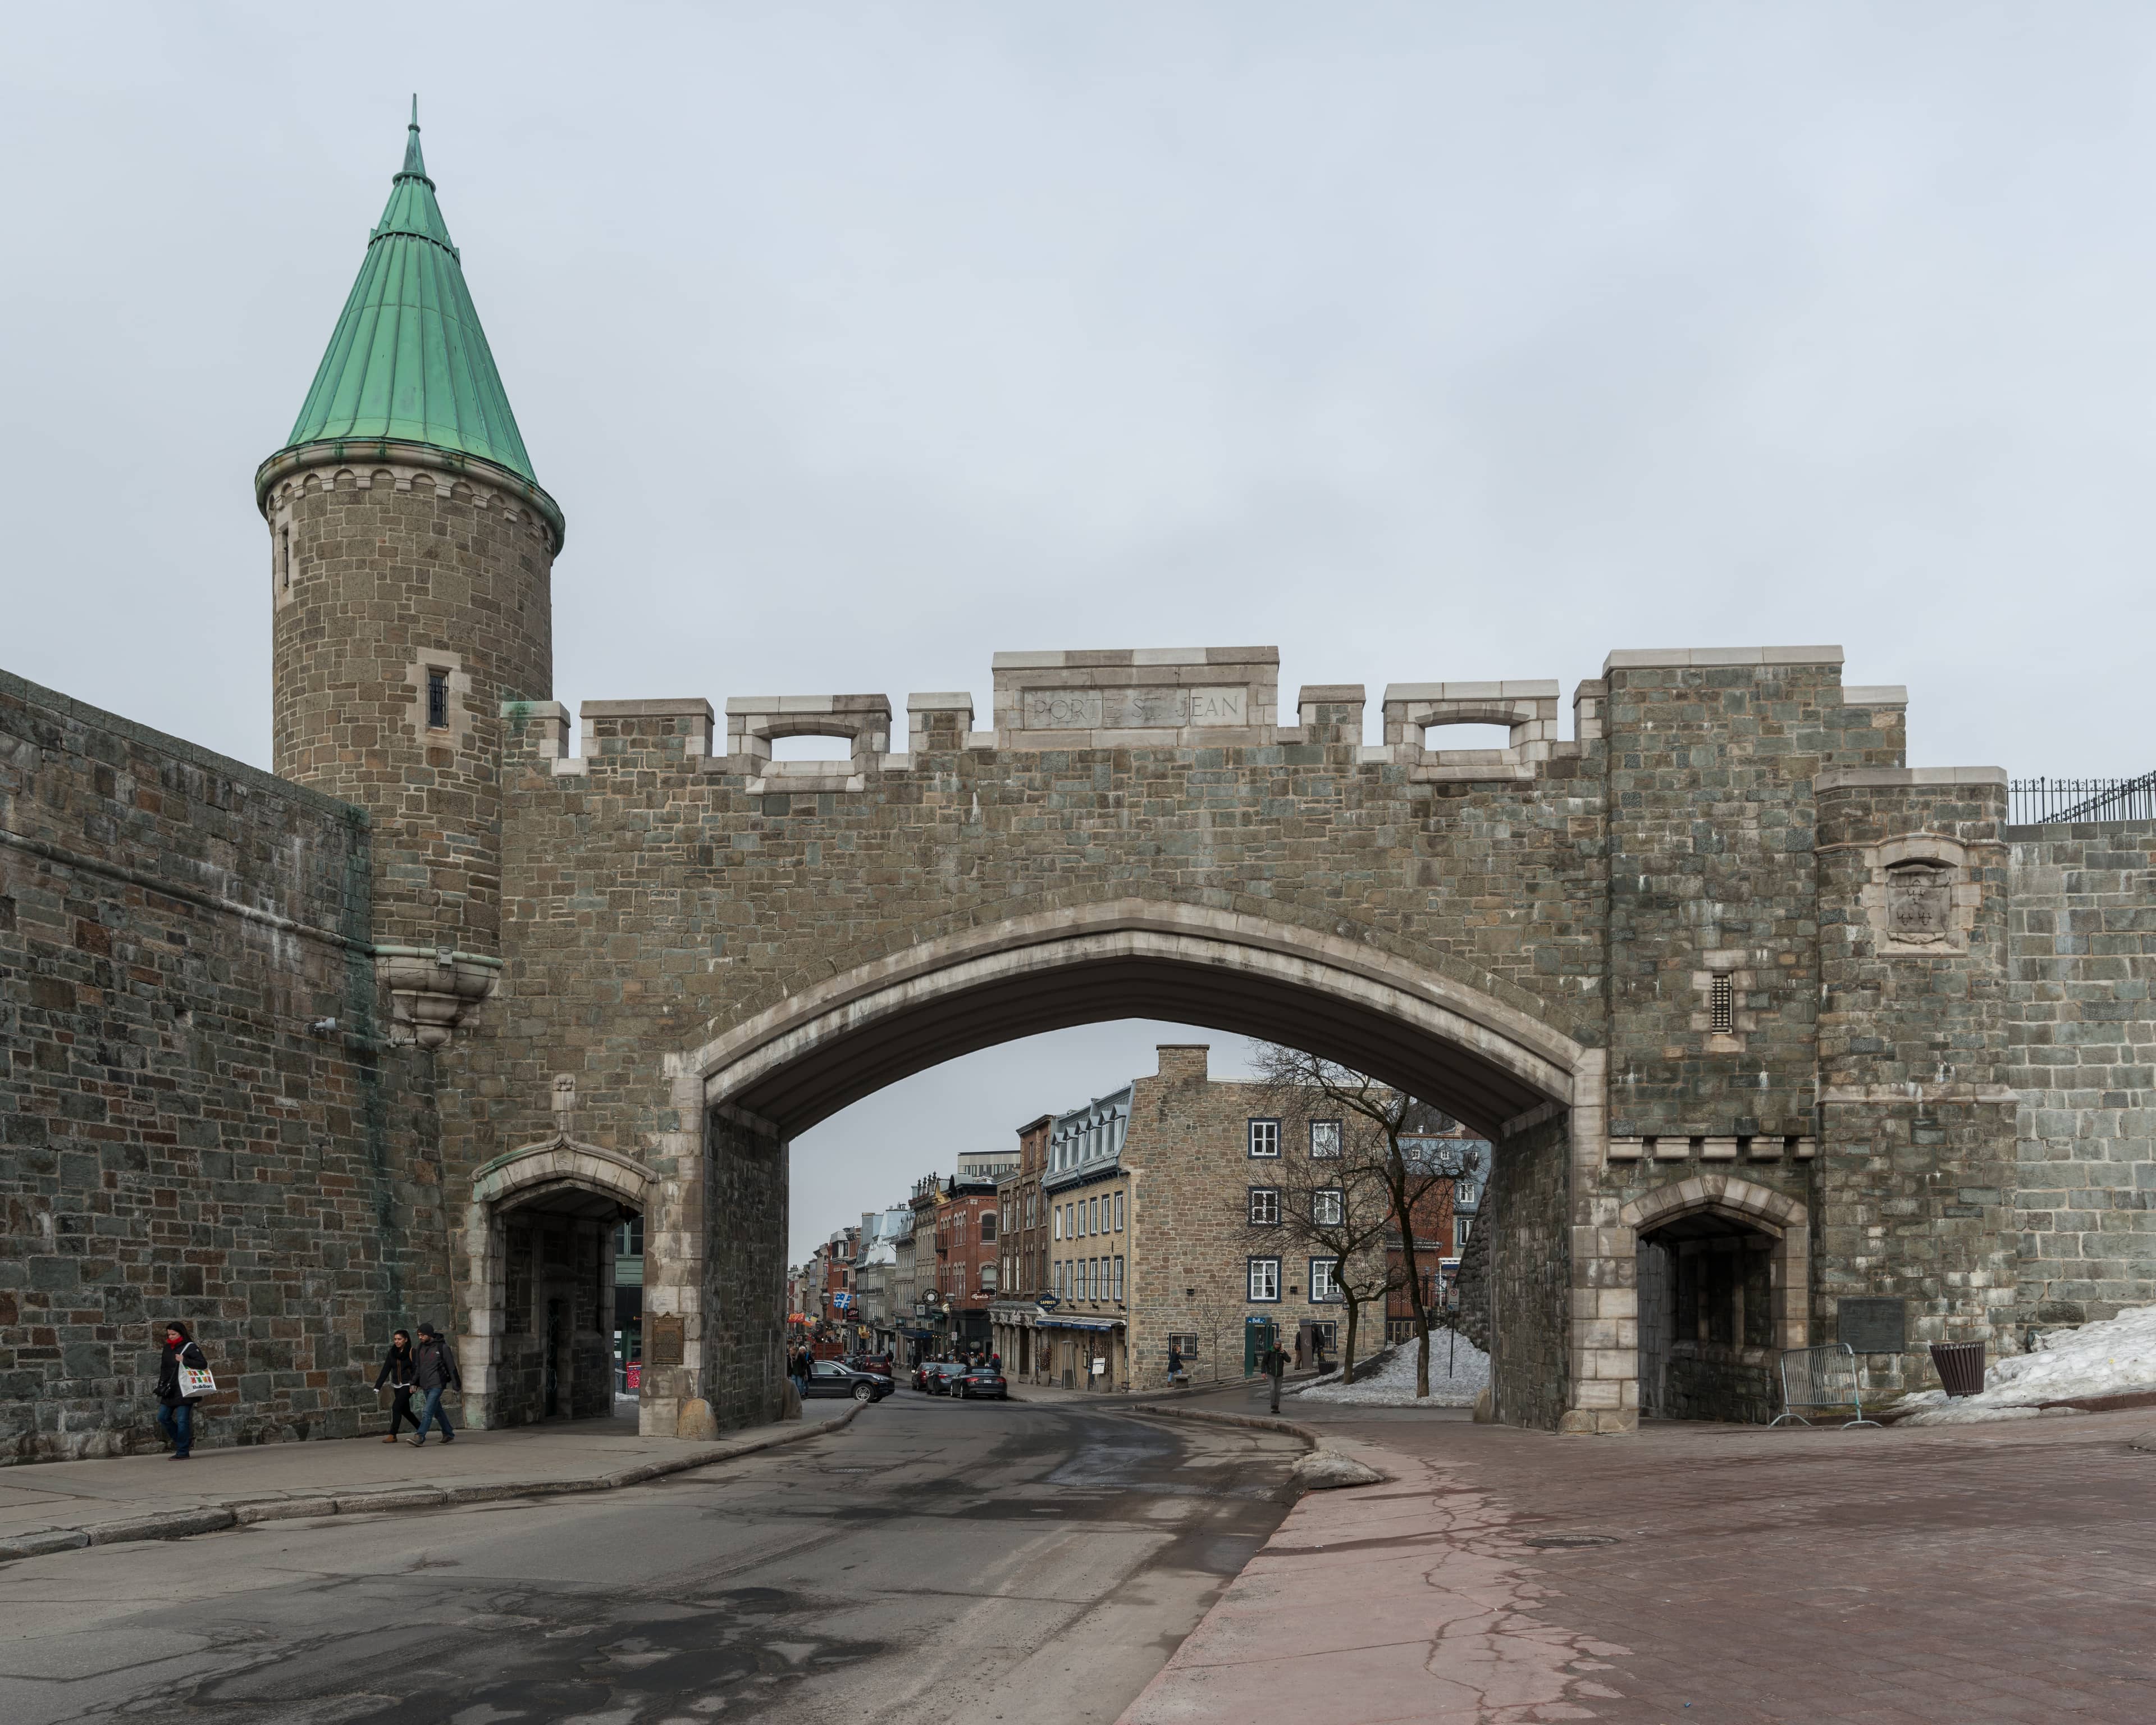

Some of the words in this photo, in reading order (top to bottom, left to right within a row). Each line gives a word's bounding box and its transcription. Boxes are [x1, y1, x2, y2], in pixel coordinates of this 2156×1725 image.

[1034, 698, 1119, 720] PORTE
[1132, 697, 1162, 719] ST.
[1175, 696, 1238, 718] JEAN
